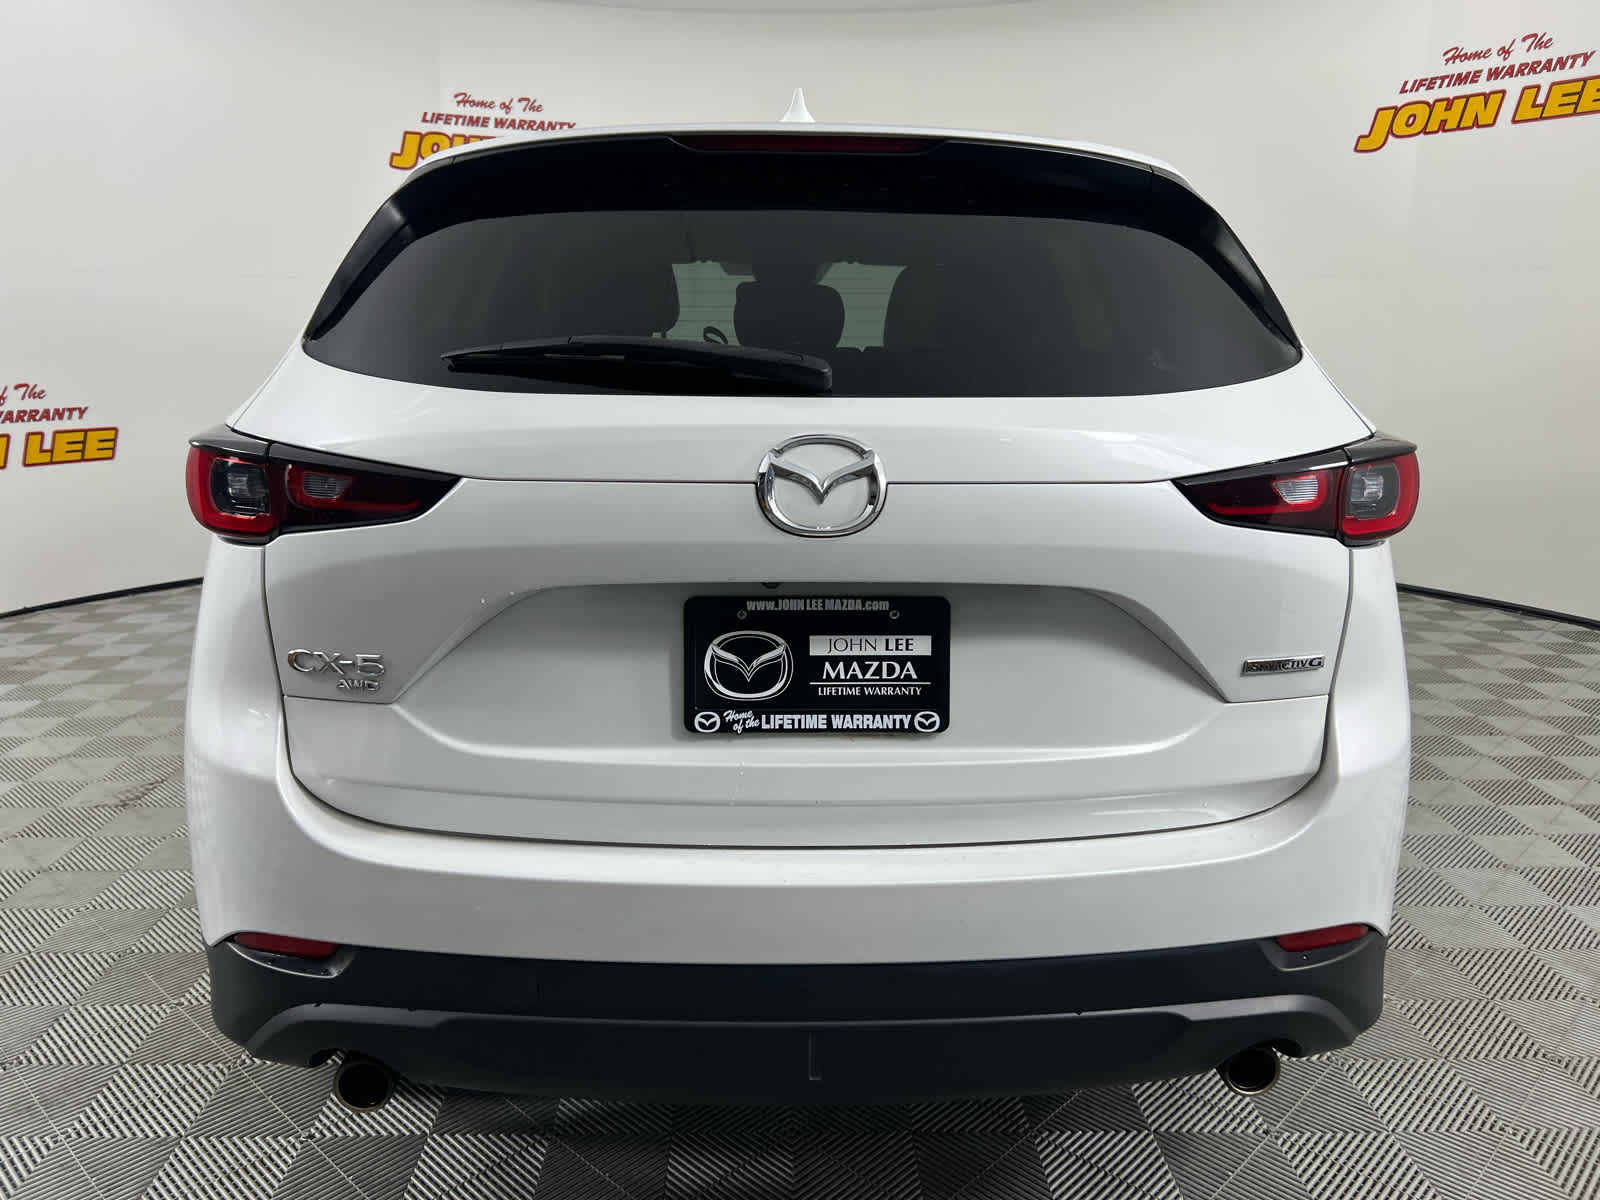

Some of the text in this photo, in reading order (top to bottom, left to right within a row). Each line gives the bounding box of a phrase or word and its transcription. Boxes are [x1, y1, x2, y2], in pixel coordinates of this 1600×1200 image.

[1442, 32, 1553, 65] Home of The
[1399, 50, 1596, 94] LIFETIME WARRANTY
[453, 92, 544, 114] Home of The
[421, 112, 490, 128] LIFETIME
[1353, 74, 1600, 153] JOHN LEE
[389, 131, 498, 170] JO
[13, 383, 47, 401] The
[0, 406, 88, 424] ARRANTY
[22, 426, 119, 467] LEE
[827, 637, 914, 654] JOHN LEE
[287, 648, 385, 676] CX-5
[822, 661, 918, 680] MAZDA
[818, 686, 922, 696] LIFETIME WARRANTY
[723, 710, 753, 722] Home
[733, 716, 760, 734] of the
[761, 714, 912, 729] LIFETIME WARRANTY
